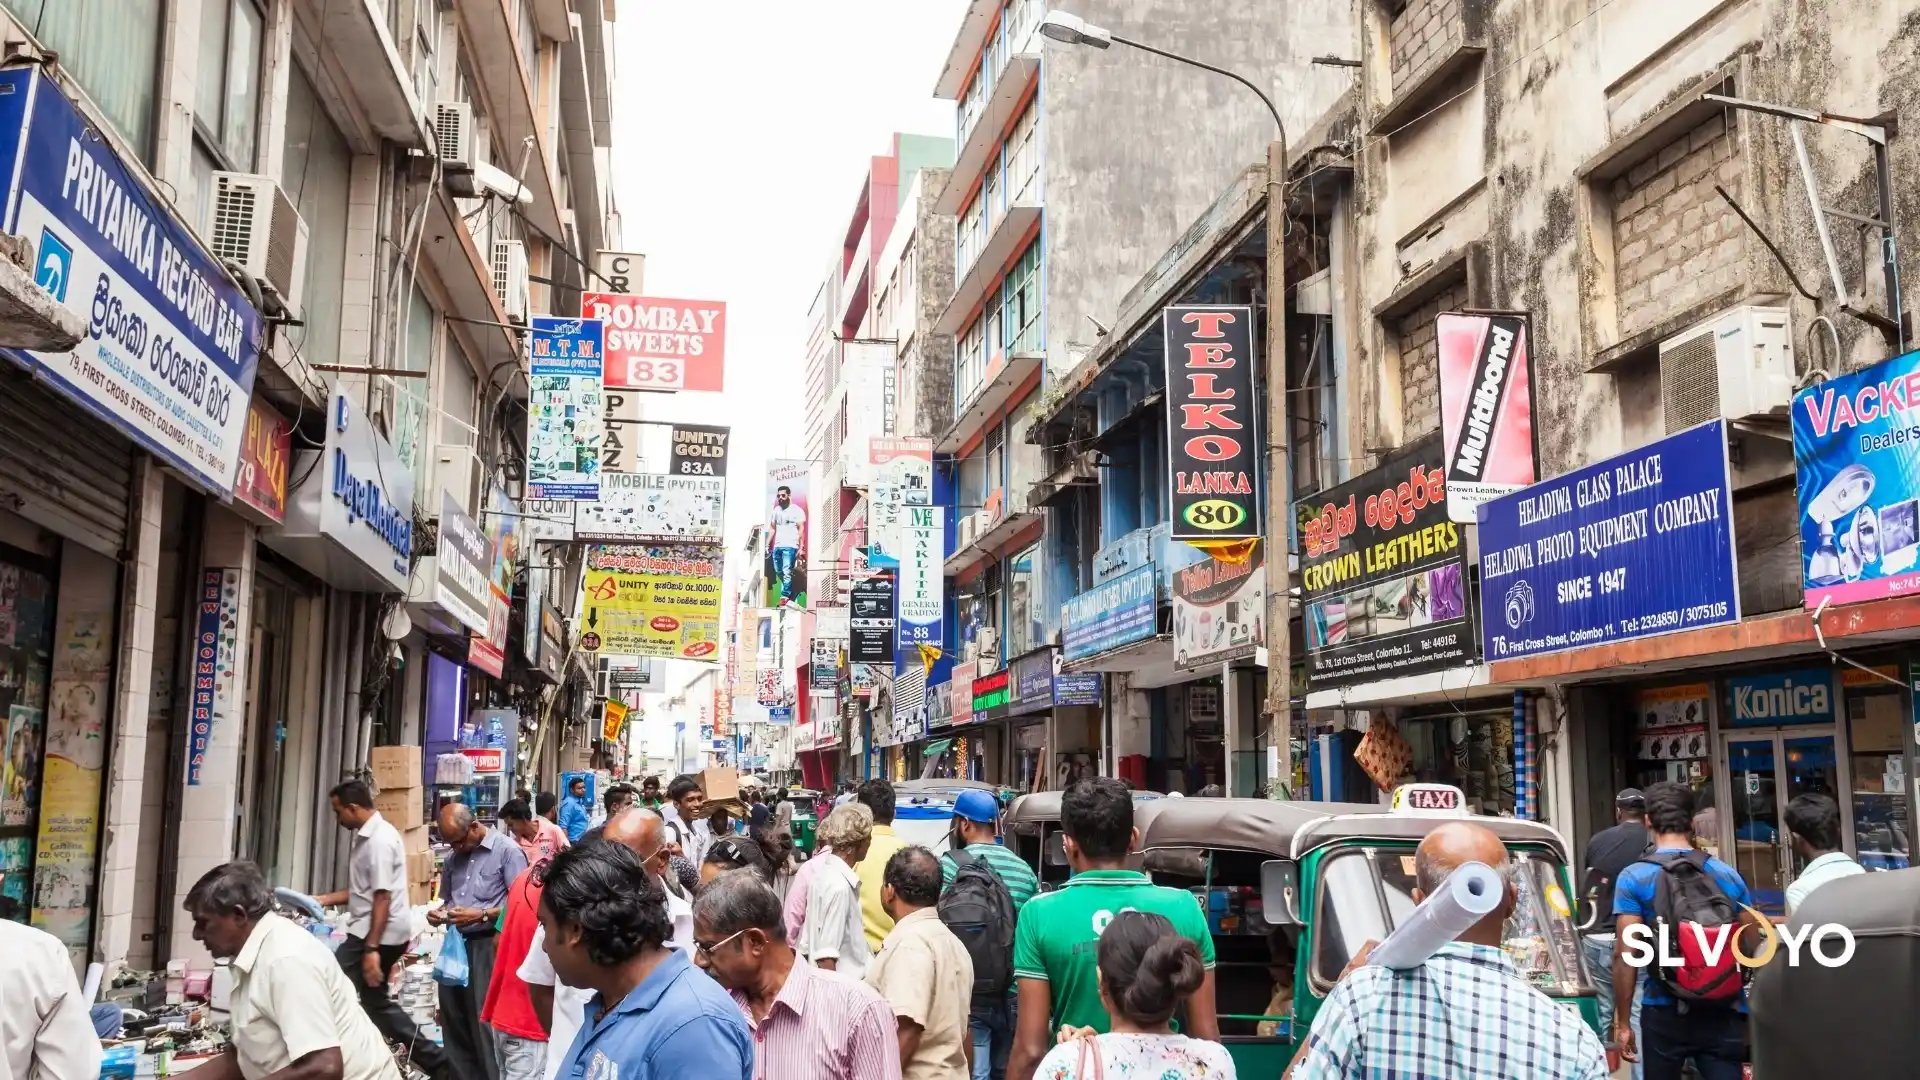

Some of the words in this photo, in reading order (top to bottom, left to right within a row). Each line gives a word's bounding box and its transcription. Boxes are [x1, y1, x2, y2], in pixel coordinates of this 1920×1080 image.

[62, 136, 155, 281] PRIYANKA
[157, 237, 215, 337] RECORD
[215, 297, 243, 364] BAR
[594, 303, 720, 334] BOMBAY
[607, 330, 704, 356] SWEETS
[98, 344, 131, 379] WHOLESALE
[633, 360, 678, 383] 83
[82, 362, 105, 386] FIRST
[106, 380, 128, 405] CROSS
[130, 397, 156, 428] STREET,
[157, 416, 185, 446] COLOMBO
[1180, 312, 1243, 461] TELKO
[1456, 325, 1514, 477] Multibond
[602, 395, 624, 472] PLAZ
[673, 431, 727, 445] UNITY
[248, 408, 284, 512] PLAZA
[676, 445, 724, 458] GOLD
[681, 462, 714, 475] 83A
[237, 457, 255, 493] 79
[608, 475, 665, 489] MOBILE
[667, 480, 696, 491] (PVT)
[1177, 471, 1251, 494] LANKA
[1518, 487, 1572, 526] HELADIWA
[1576, 470, 1610, 508] GLASS
[1615, 454, 1663, 495] PALACE
[1192, 505, 1239, 524] 80
[1484, 543, 1533, 580] HELADIWA
[1536, 530, 1574, 566] PHOTO
[1578, 508, 1648, 559] EQUIPMENT
[1654, 487, 1720, 533] COMPANY
[914, 530, 931, 599] MAKLITE
[1304, 551, 1360, 591] CROWN
[1365, 521, 1459, 574] LEATHERS
[202, 572, 220, 614] NEW
[619, 580, 650, 590] UNITY
[1182, 565, 1212, 595] Telko
[1557, 576, 1592, 604] SINCE
[1598, 568, 1626, 594] 1947
[903, 608, 940, 616] TRADING
[1509, 640, 1524, 652] First
[1525, 638, 1545, 651] Cross
[1546, 633, 1569, 649] Street,
[1570, 627, 1603, 643] Colombo
[1604, 623, 1616, 637] 11.
[1620, 618, 1639, 634] Tel:
[1640, 612, 1678, 630] 2324850
[1686, 601, 1728, 621] 3075105
[914, 627, 929, 639] 88
[1334, 658, 1342, 666] 1st
[1342, 655, 1356, 665] Cross
[1357, 652, 1375, 663] Street,
[1376, 648, 1402, 659] Colombo
[1403, 644, 1412, 654] 11.
[1421, 640, 1432, 650] Tel:
[1432, 634, 1457, 647] 449162
[767, 670, 776, 695] SAS
[1733, 678, 1829, 720] Konica
[192, 632, 215, 781] COMMERCIAL
[1413, 791, 1454, 808] TAXI
